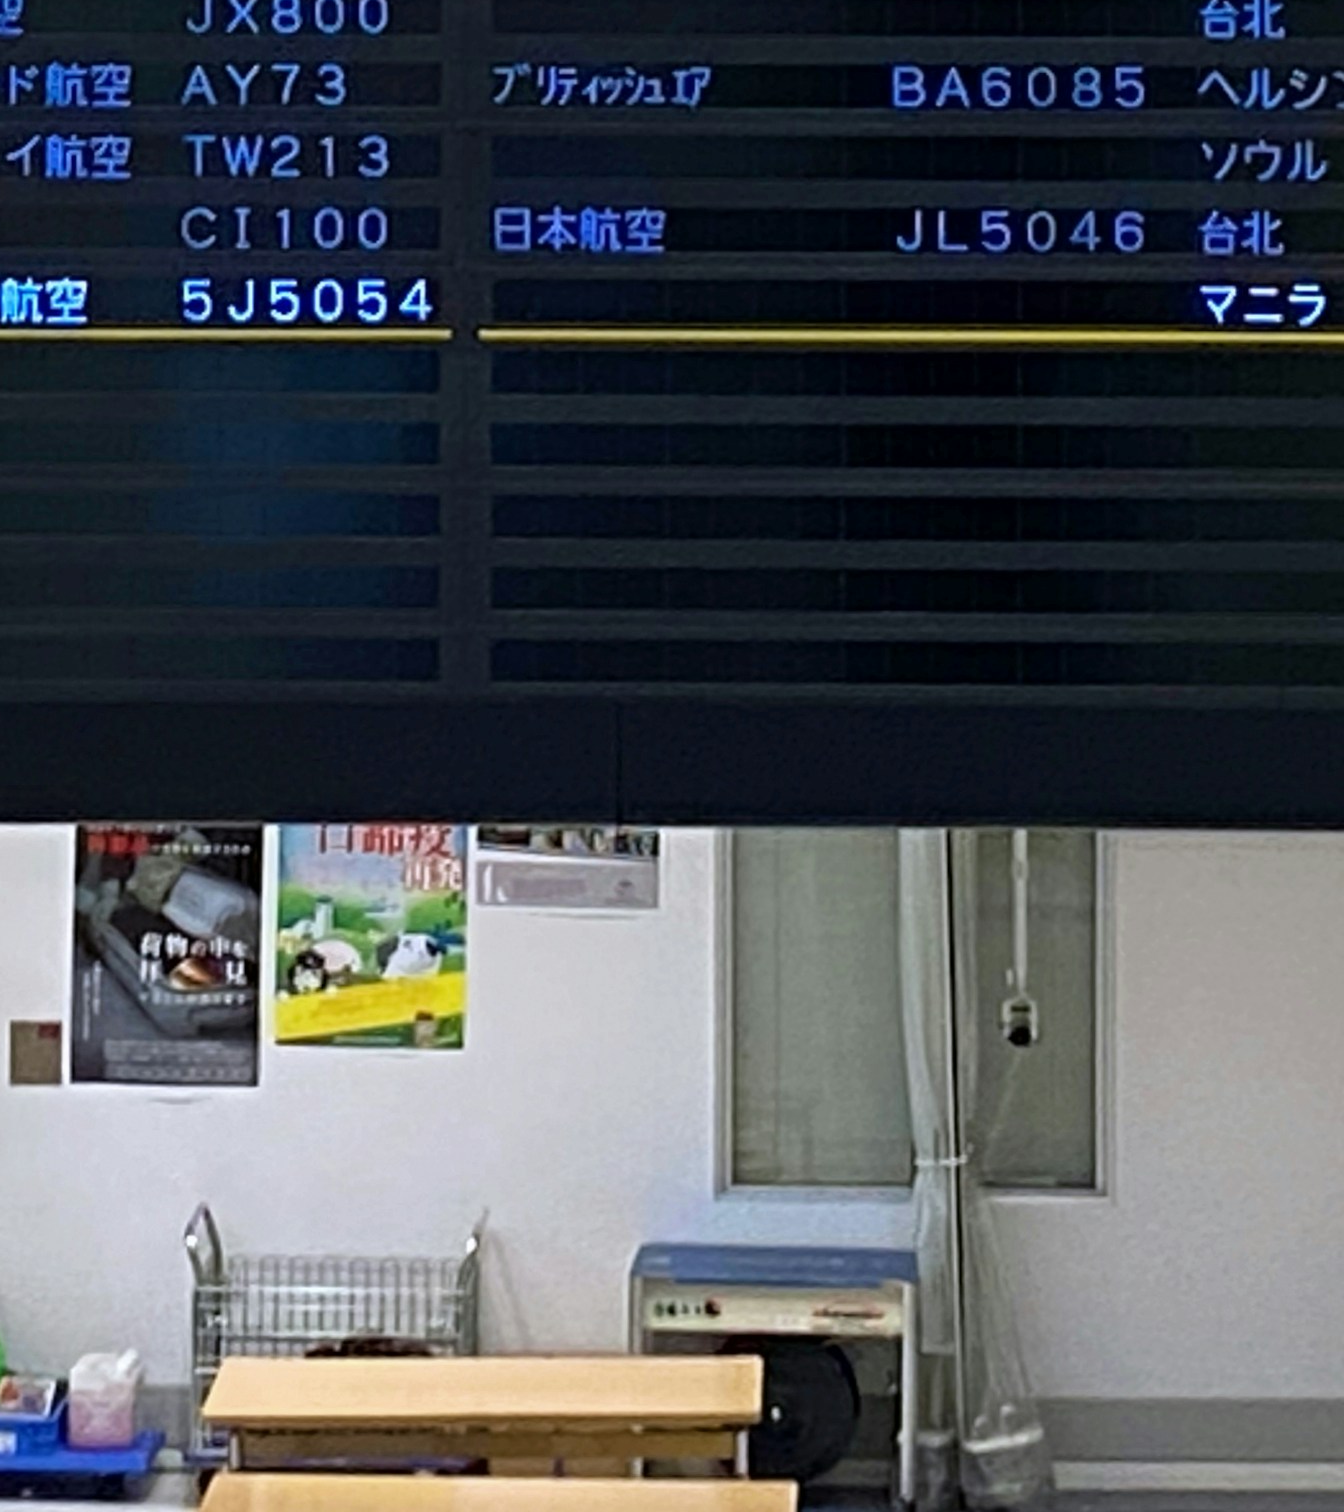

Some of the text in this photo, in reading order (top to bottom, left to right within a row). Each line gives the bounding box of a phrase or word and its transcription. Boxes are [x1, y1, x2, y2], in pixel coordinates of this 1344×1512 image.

[181, 62, 347, 107] AY73
[891, 65, 1146, 109] BA6085
[184, 133, 390, 178] TW213
[1200, 138, 1328, 182] ソウル
[180, 206, 389, 251] CI100
[493, 205, 667, 254] 日本航空
[895, 209, 1145, 253] JL5046
[1197, 209, 1285, 257] 台北
[181, 278, 435, 324] 5J5054
[1198, 283, 1328, 328] マニラ
